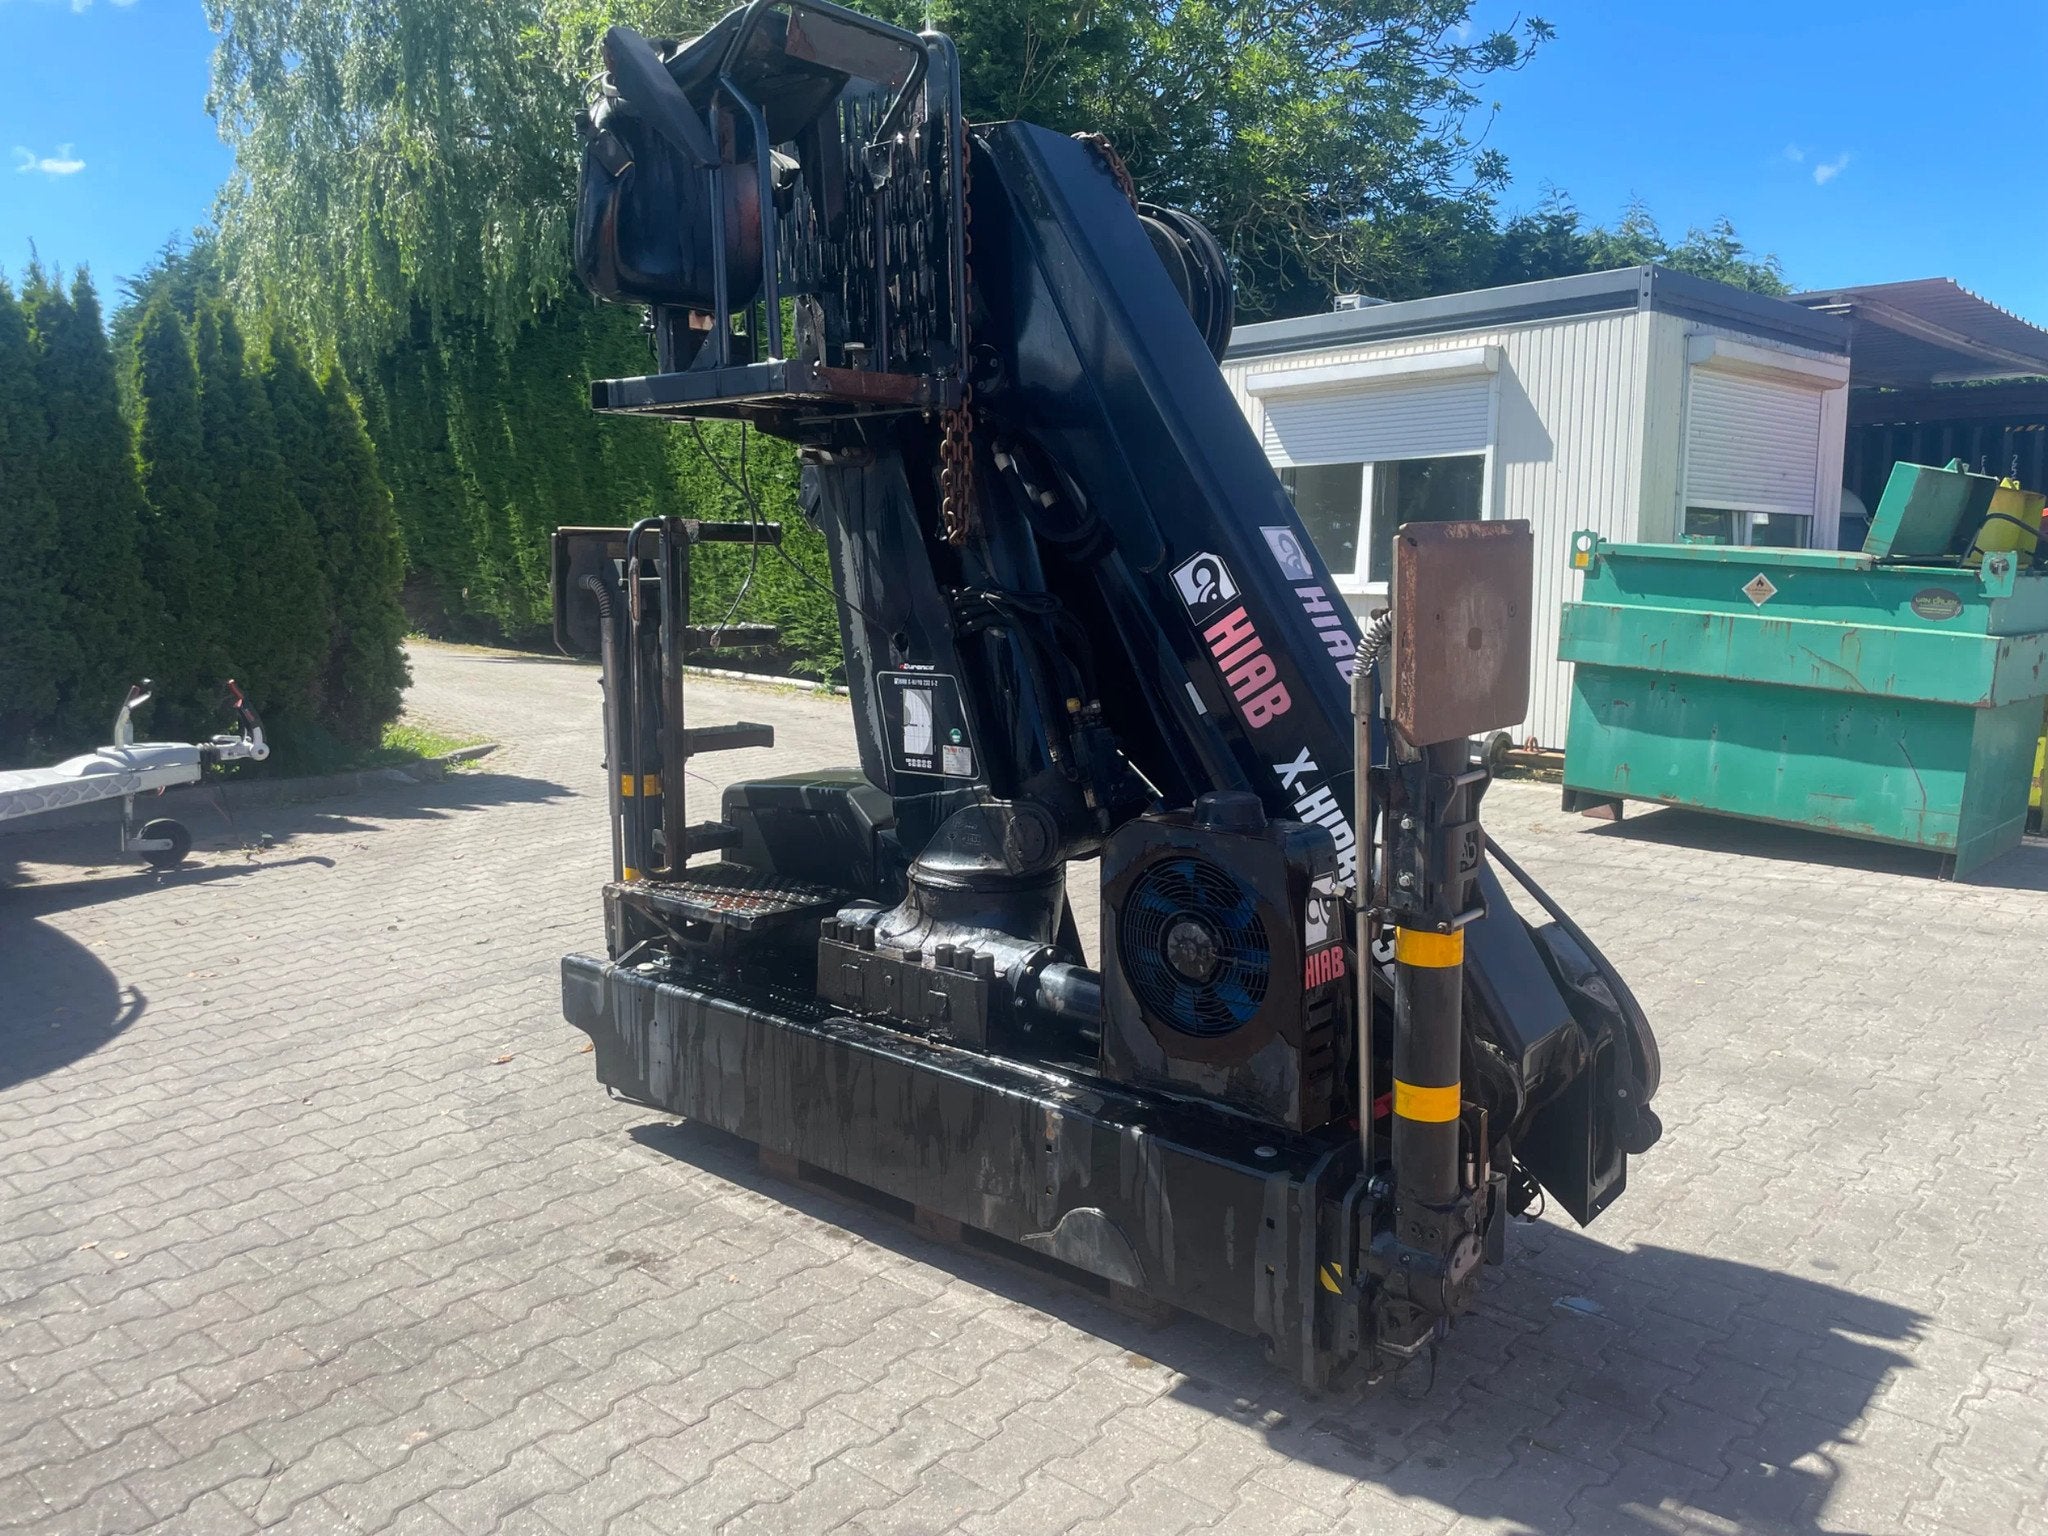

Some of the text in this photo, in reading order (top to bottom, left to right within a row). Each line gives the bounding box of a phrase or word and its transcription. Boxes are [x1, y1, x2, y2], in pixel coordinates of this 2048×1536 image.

[1203, 606, 1291, 728] HIAB
[1273, 746, 1356, 888] X-HIPR
[1305, 946, 1344, 990] HIAB
